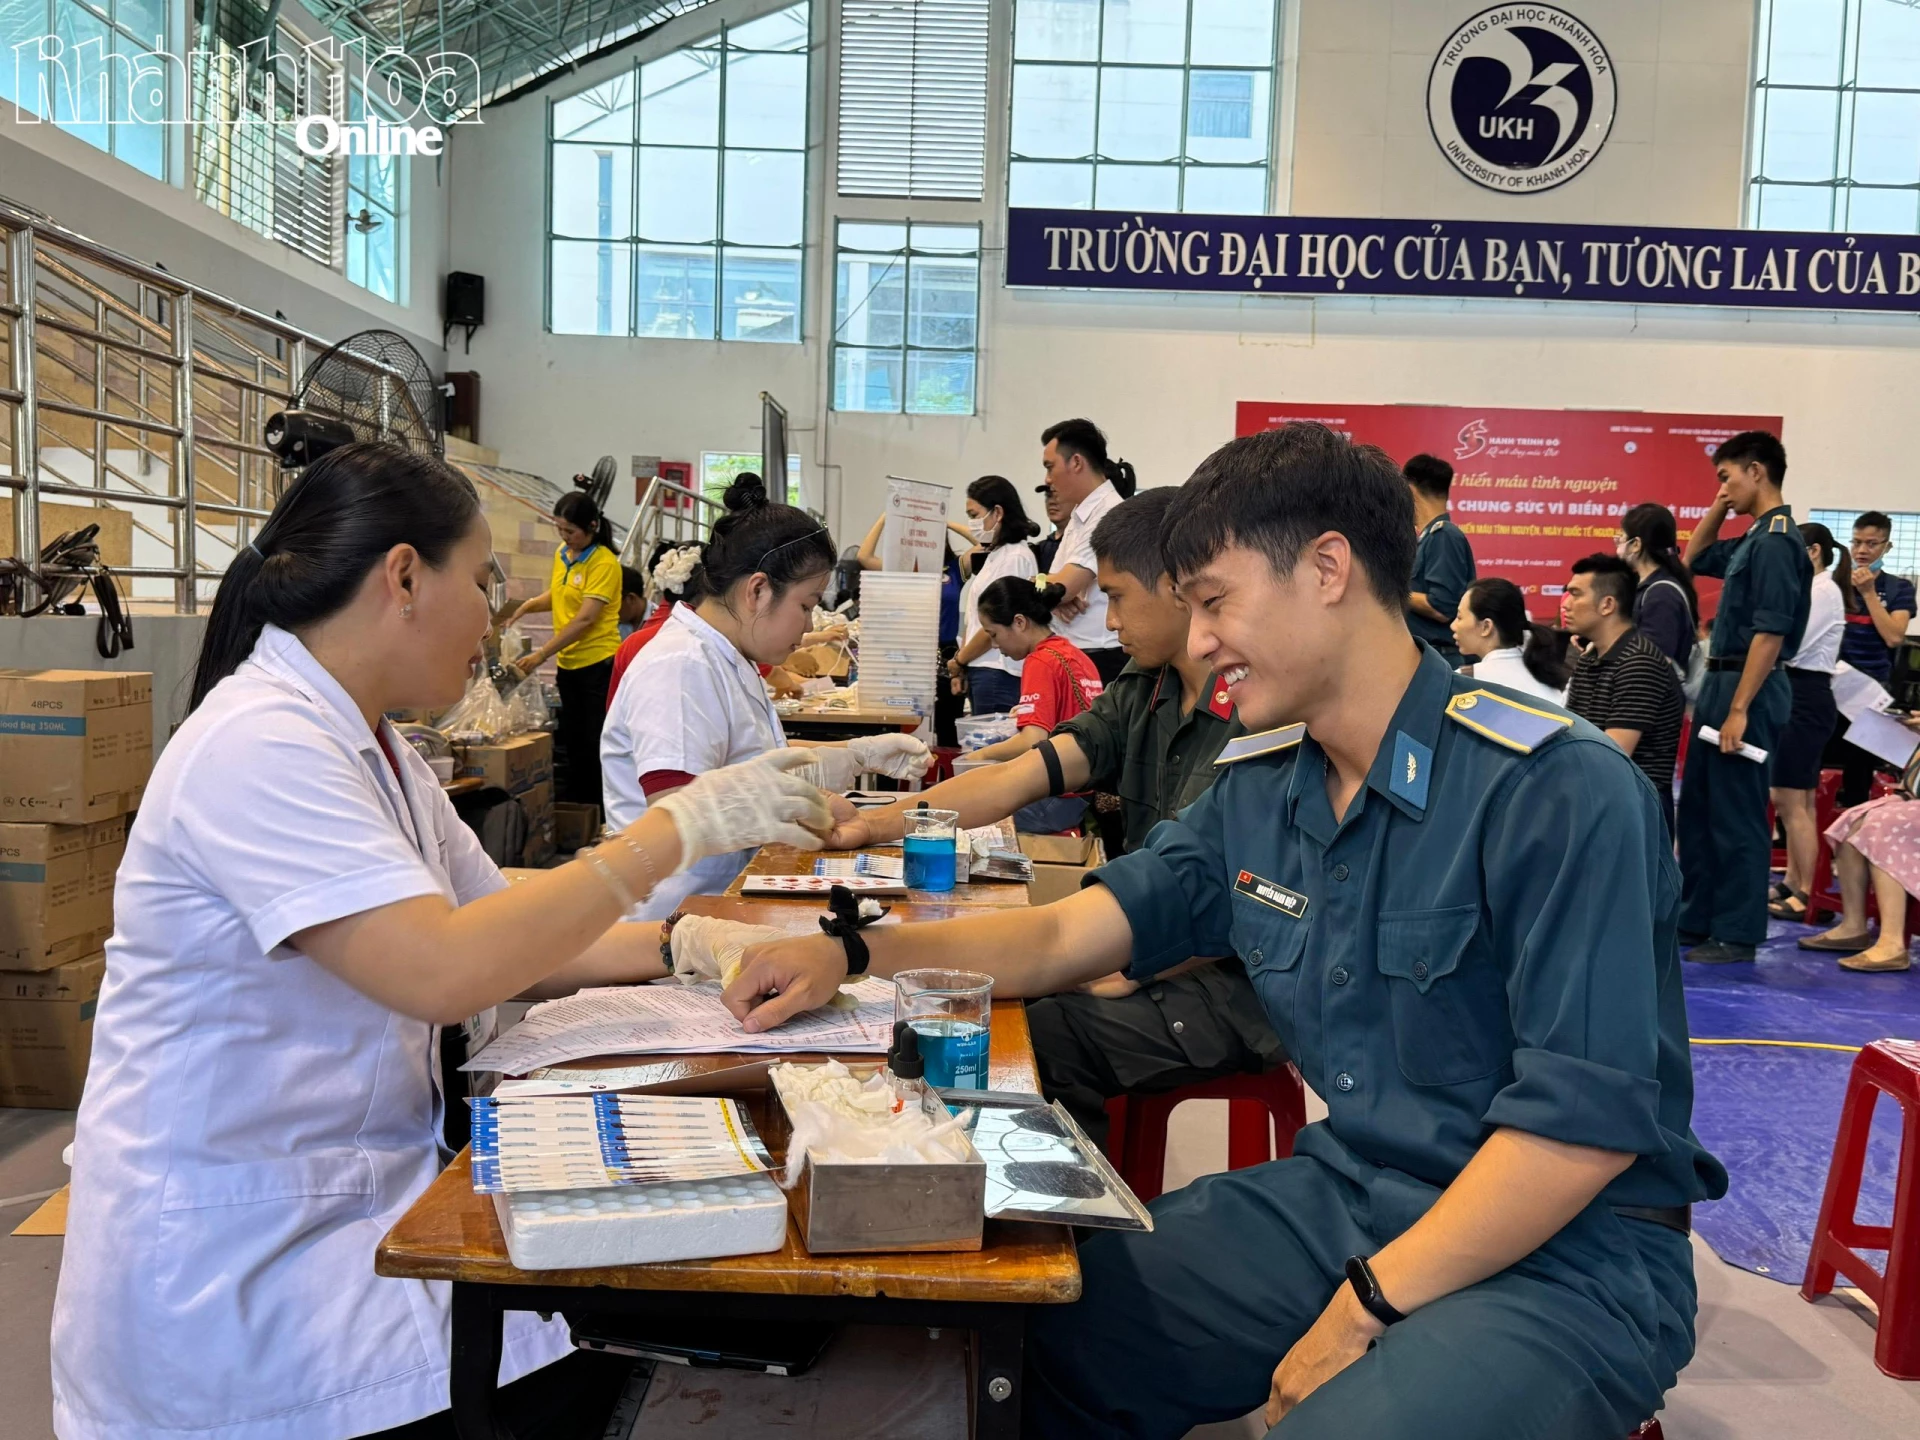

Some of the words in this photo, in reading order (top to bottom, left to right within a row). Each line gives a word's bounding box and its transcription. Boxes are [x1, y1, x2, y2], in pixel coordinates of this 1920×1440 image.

[1442, 20, 1489, 68] TRƯỜNG
[1490, 10, 1513, 26] ĐẠI
[1517, 9, 1546, 22] HỌC
[1549, 13, 1591, 49] KHÁNH
[1478, 116, 1534, 140] UKH
[1446, 140, 1505, 185] UNIVERSITY
[1507, 176, 1523, 187] OF
[1526, 164, 1567, 187] KHANH
[1568, 147, 1590, 170] HOA
[1044, 217, 1210, 275] TRƯỜNG
[1218, 232, 1288, 288] ĐẠI
[1298, 233, 1385, 290] HỌC
[1395, 224, 1474, 281] CỦA
[1482, 238, 1572, 294] BẠN,
[1582, 236, 1722, 289] TƯƠNG
[1730, 247, 1800, 292] LAI
[1808, 237, 1889, 294] CỦA
[1460, 472, 1492, 487] hiến
[1494, 474, 1528, 488] máu
[1563, 476, 1618, 493] nguyện
[1457, 500, 1512, 513] CHUNG
[1607, 501, 1638, 516] ĐẢ
[31, 701, 63, 710] 48PCS
[0, 721, 18, 729] lood
[20, 722, 36, 731] Bag
[0, 848, 20, 857] PCS
[955, 1063, 977, 1074] 250ml
